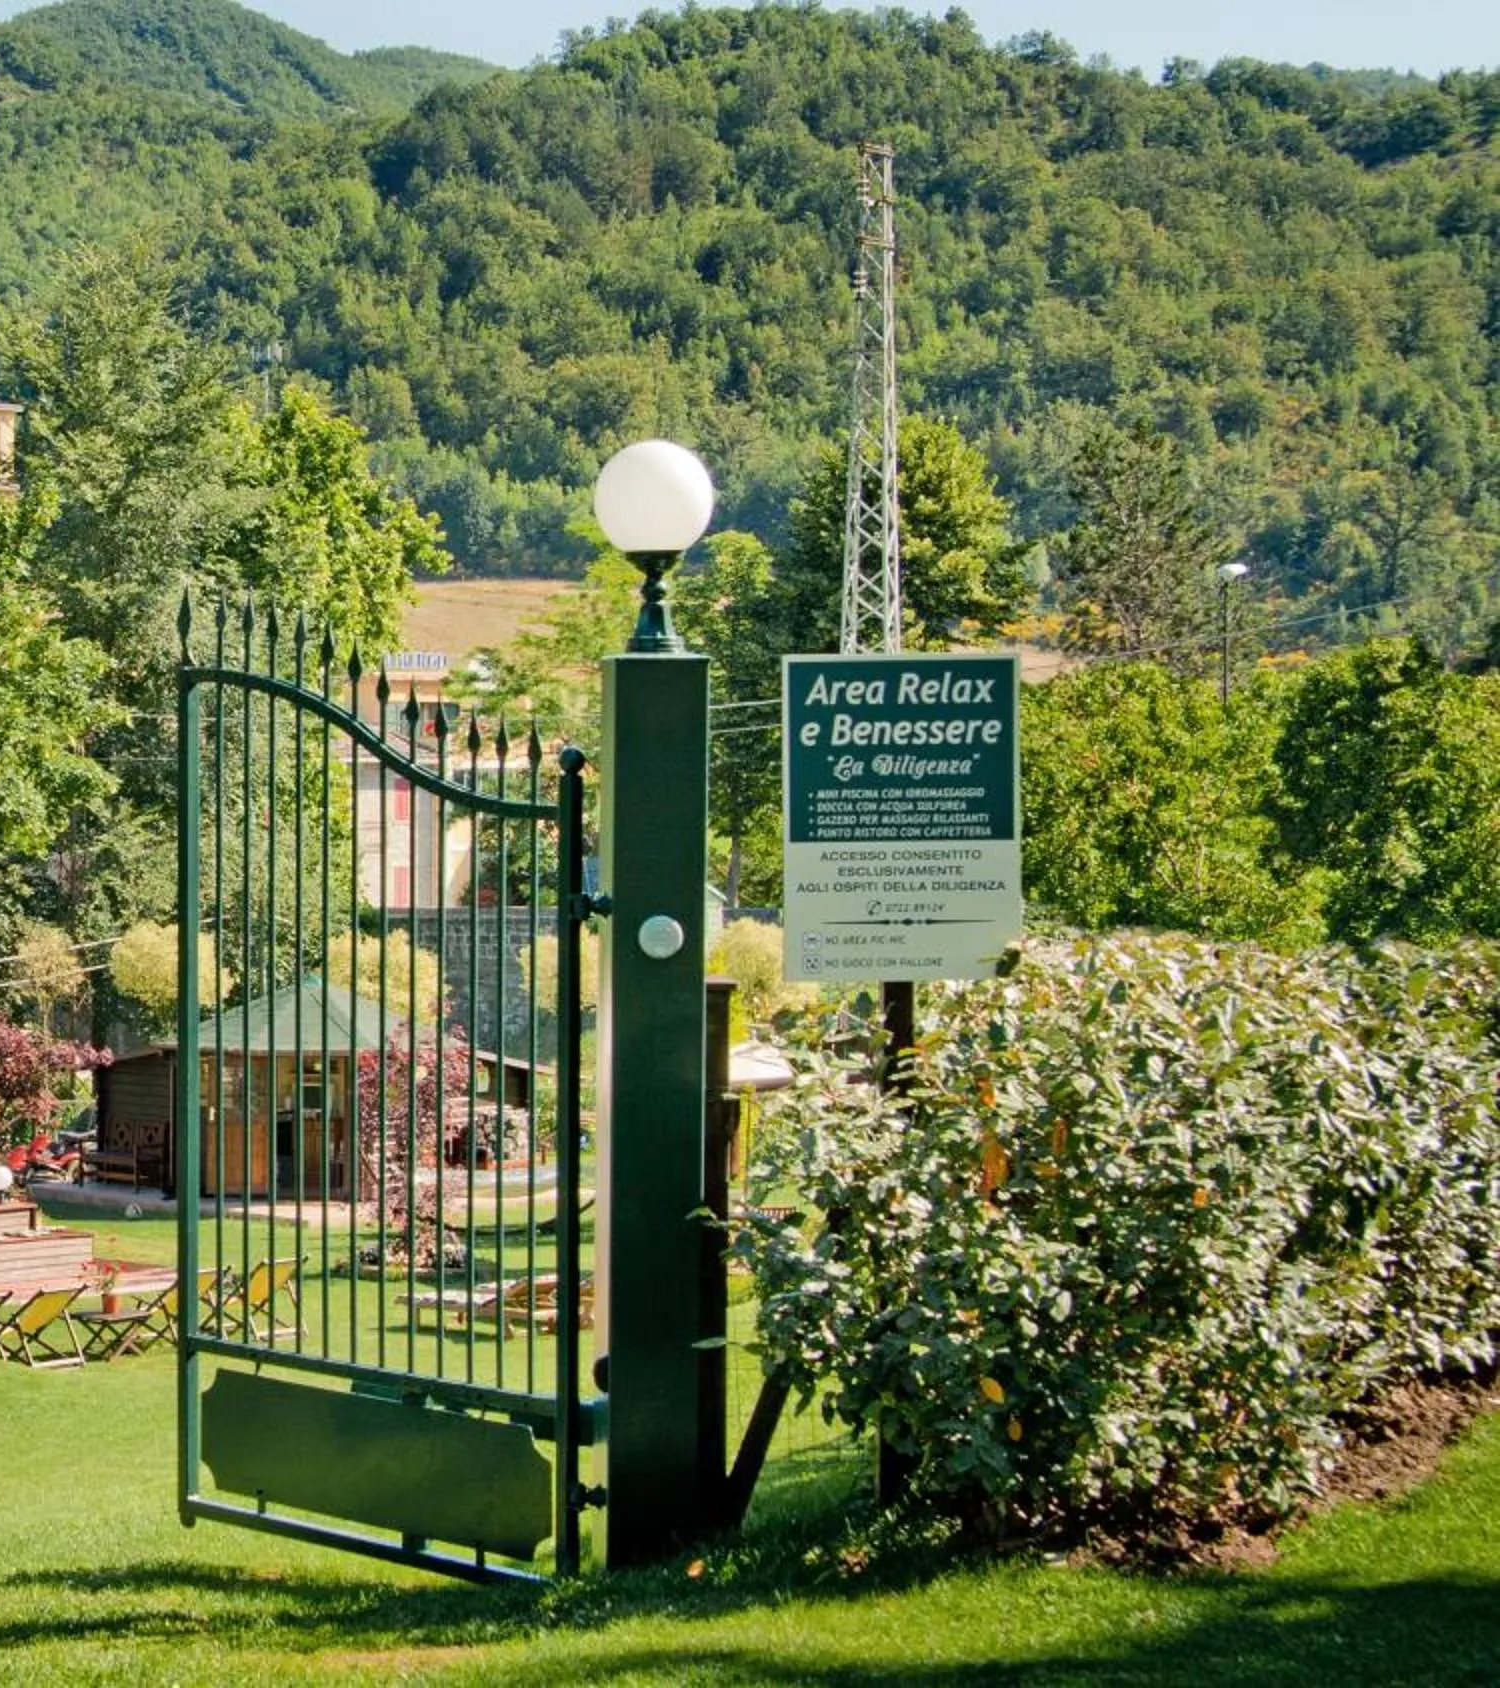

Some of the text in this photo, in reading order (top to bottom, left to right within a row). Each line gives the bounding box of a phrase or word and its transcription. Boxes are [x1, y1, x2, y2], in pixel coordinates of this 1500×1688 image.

[805, 672, 996, 705] Area Relax
[800, 714, 1002, 746] e Benessere
[817, 788, 984, 799] MINI PISCINA CON IDROMASSAGGIO
[817, 801, 966, 812] DOCCIA CON ACQUA SULFUREA
[817, 813, 989, 825] GAZEBO PER MASSAGGI RILASSANTI
[817, 826, 991, 837] PUNTO RISTORO CON CAFFETTERIA
[820, 850, 982, 861] ACCESSO CONSENTITO
[838, 866, 964, 876] ESCLUSIVAMENTE
[797, 880, 1006, 892] AGLI OSPITI DELLA DILIGENZA
[843, 936, 866, 944] AREA
[826, 958, 943, 968] NO GIOCO CON PALLONE
